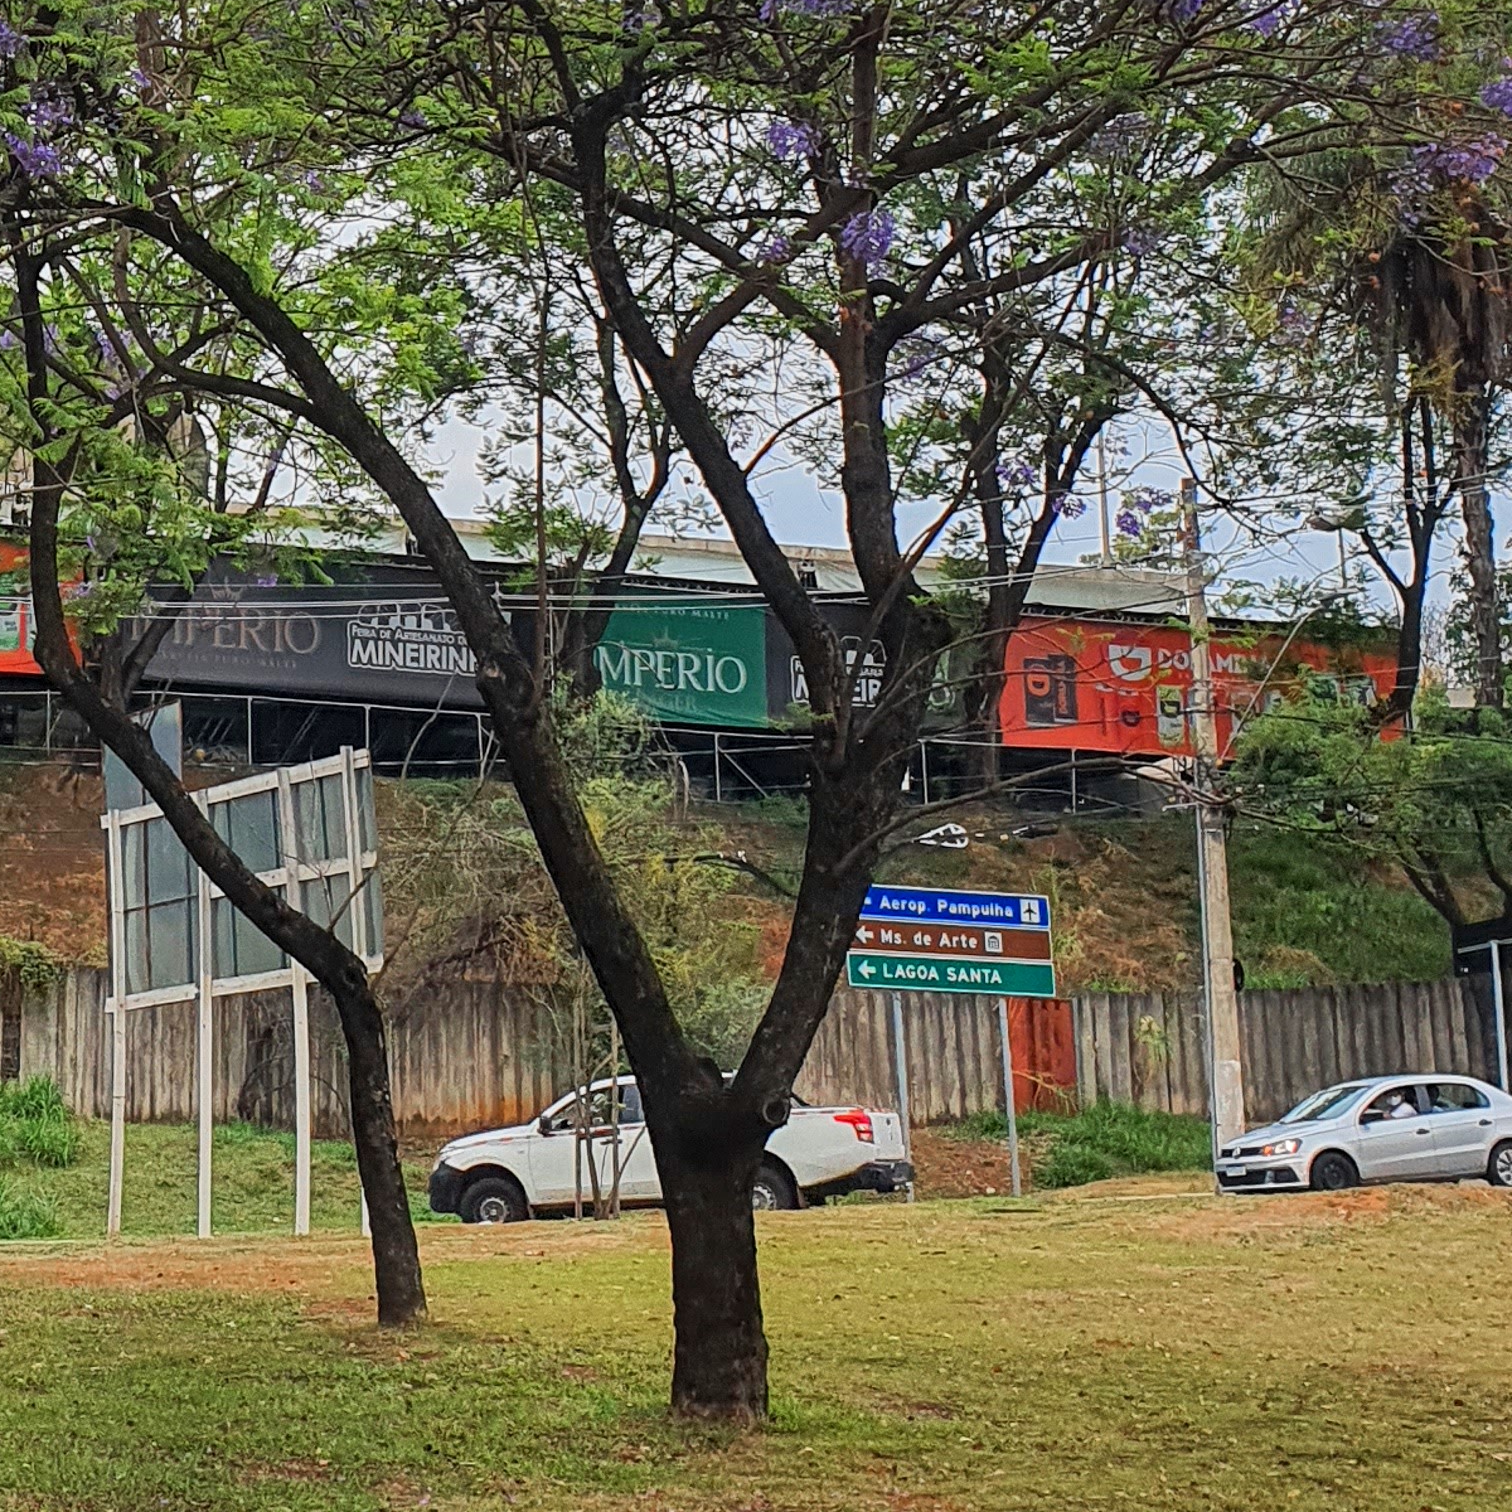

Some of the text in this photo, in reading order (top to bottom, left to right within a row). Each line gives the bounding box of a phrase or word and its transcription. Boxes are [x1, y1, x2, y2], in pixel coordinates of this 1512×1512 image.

[879, 895, 1014, 918] Aerop. Pampulha
[880, 928, 978, 949] Ms. de Arte
[882, 963, 1003, 984] LAGOA SANTA
